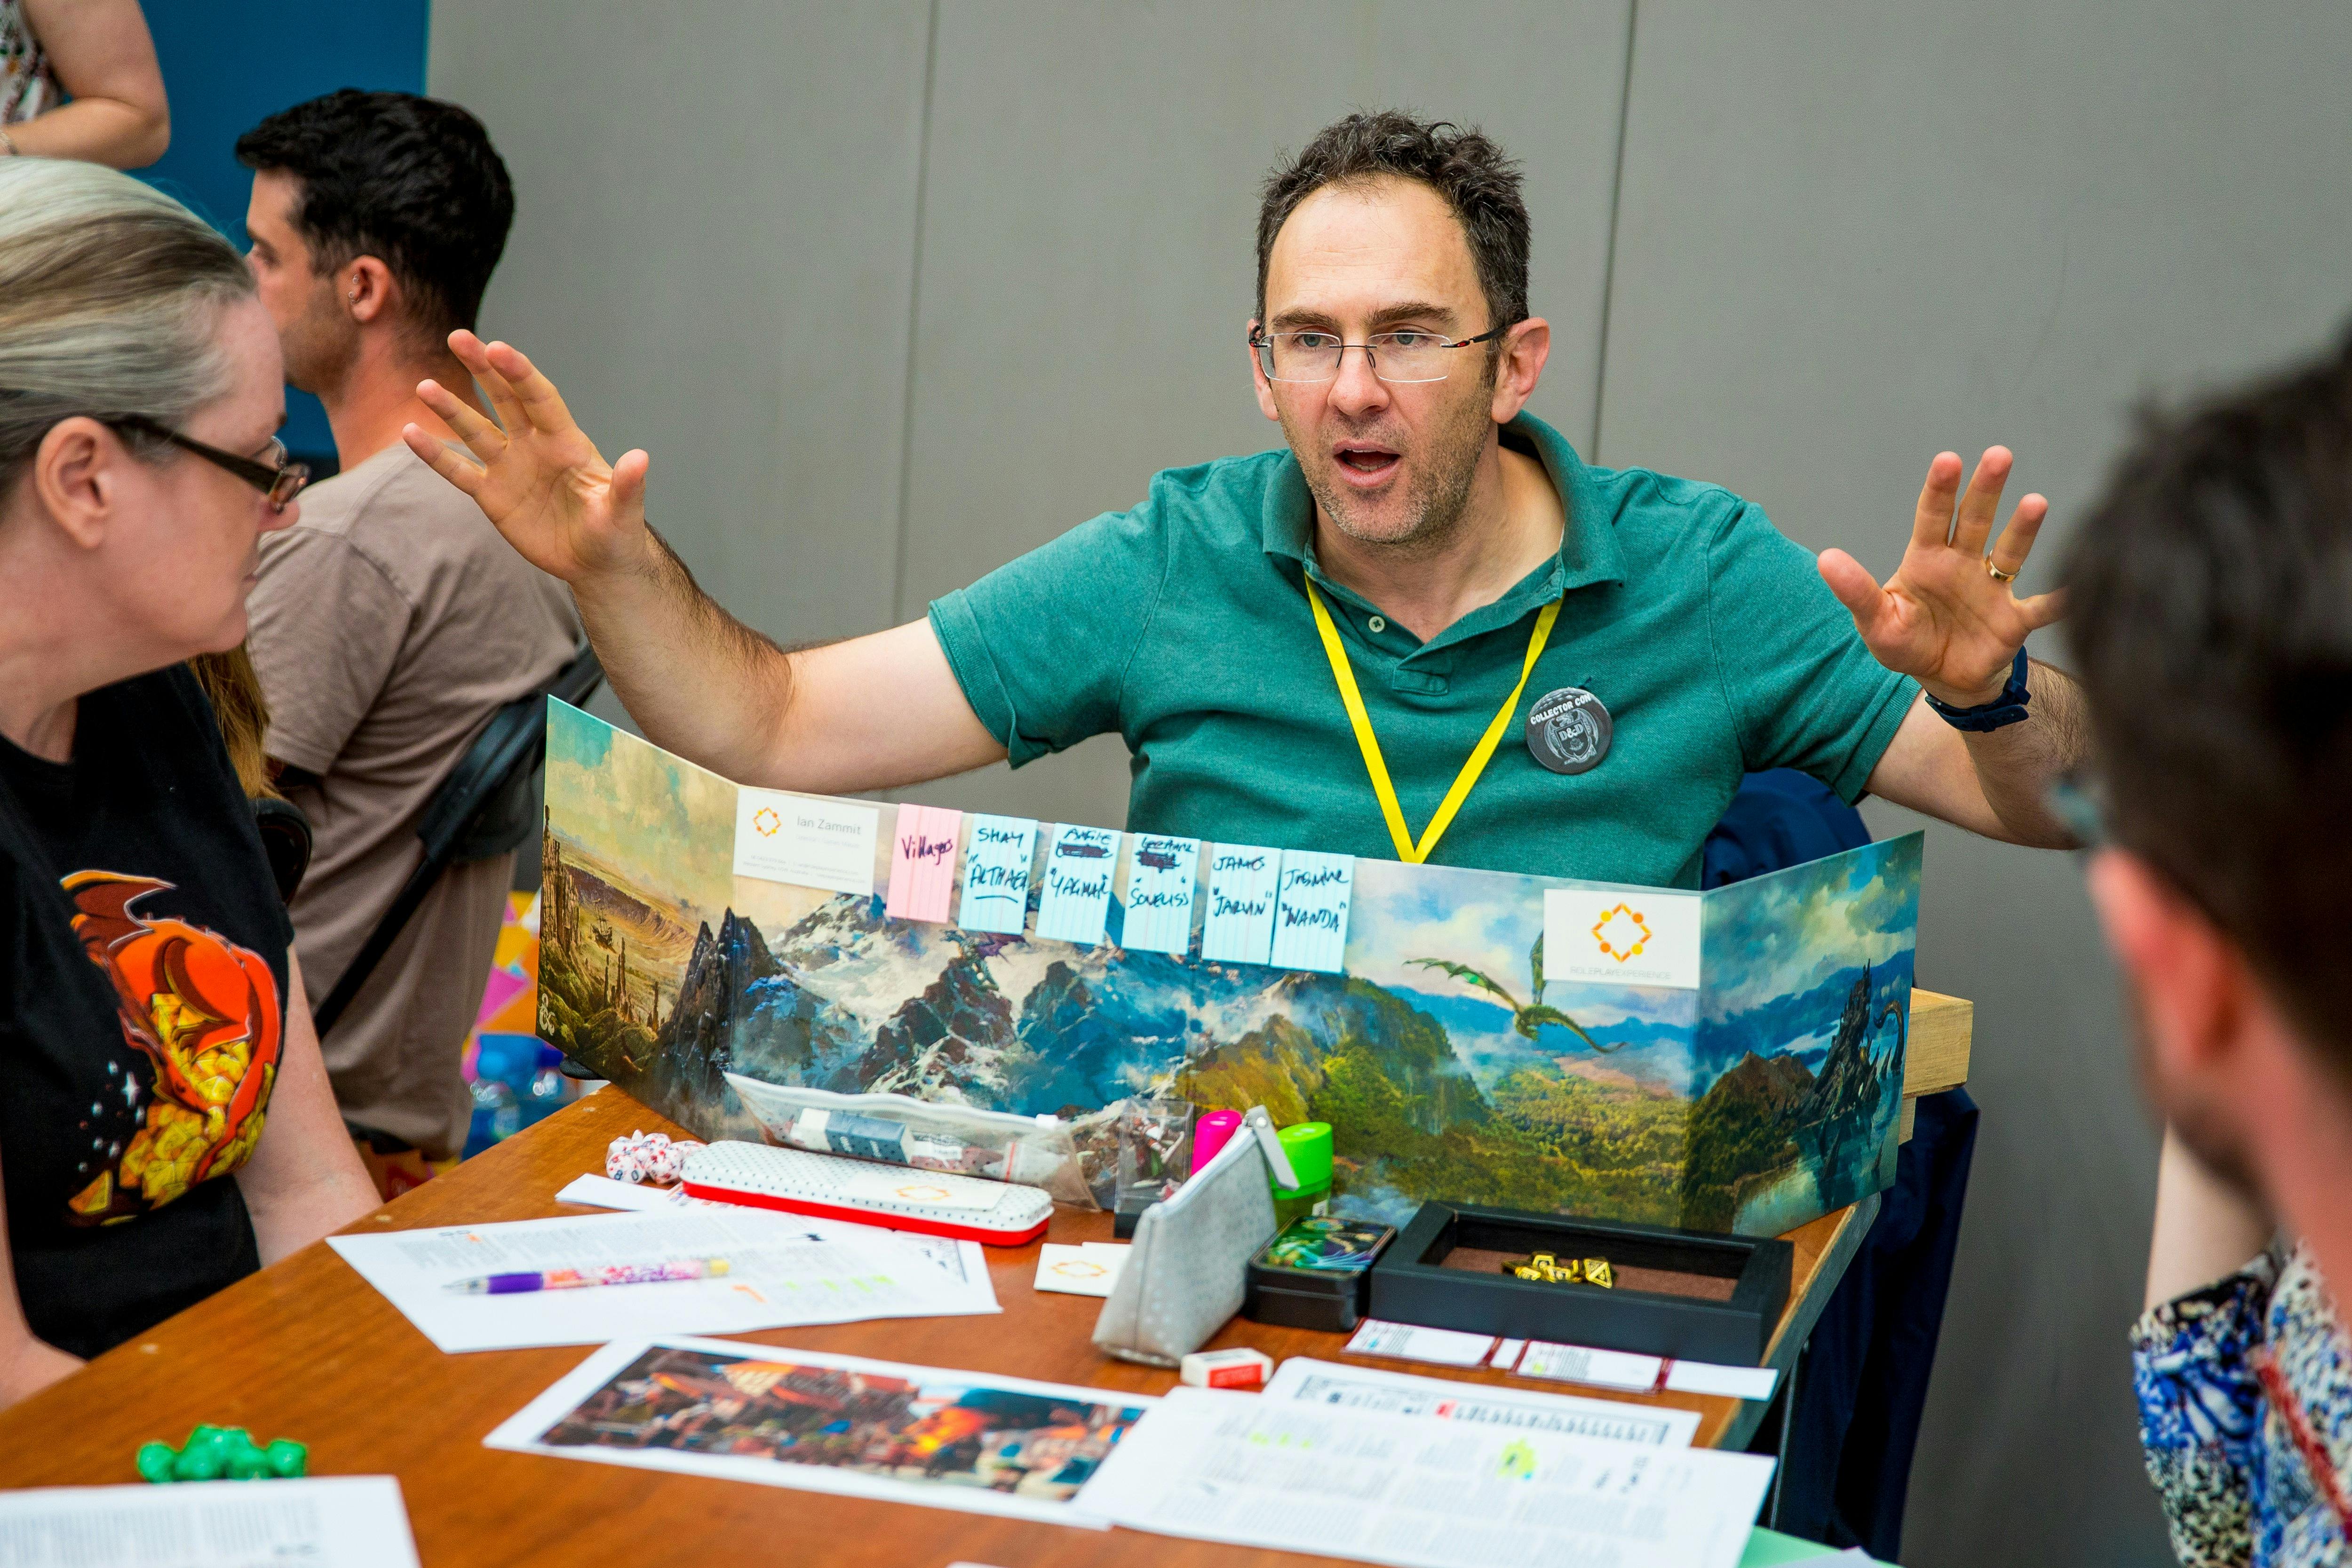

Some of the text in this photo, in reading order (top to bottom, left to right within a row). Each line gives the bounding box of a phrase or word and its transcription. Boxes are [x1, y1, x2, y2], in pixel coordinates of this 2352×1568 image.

[1530, 693, 1591, 725] COLLECTOR CON
[1558, 723, 1584, 741] D&D
[796, 815, 862, 835] Ian Zammit
